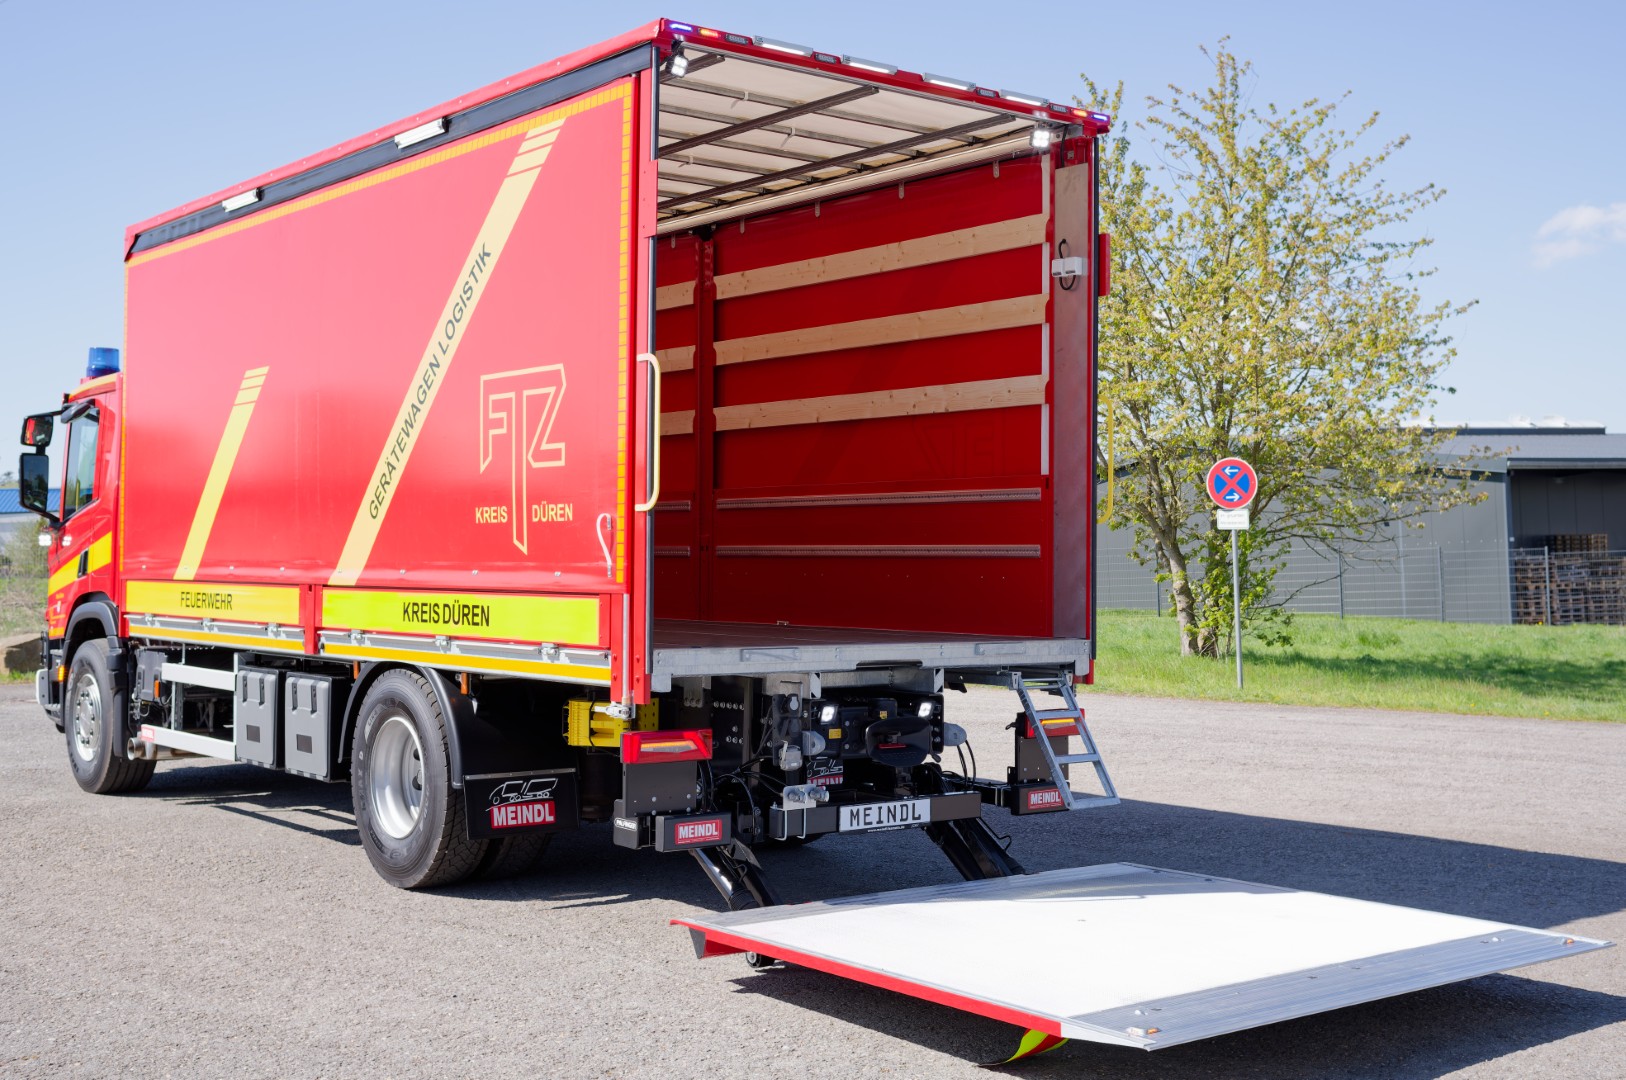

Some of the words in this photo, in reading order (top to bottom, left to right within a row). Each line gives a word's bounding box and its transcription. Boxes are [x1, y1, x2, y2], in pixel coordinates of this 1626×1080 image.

[369, 353, 441, 520] GERÄTEWAGEN
[437, 243, 492, 356] LOGISTIK
[480, 363, 567, 556] FTZ
[475, 506, 508, 524] KREIS
[531, 501, 573, 523] DÜREN
[180, 591, 233, 611] FEUERWEHR
[402, 601, 441, 625] KREIS
[442, 600, 490, 627] DÜREN
[1030, 791, 1060, 805] MEINDL
[493, 803, 555, 827] MEINDL
[850, 803, 921, 828] MEINDL
[678, 823, 718, 839] MEINDL
